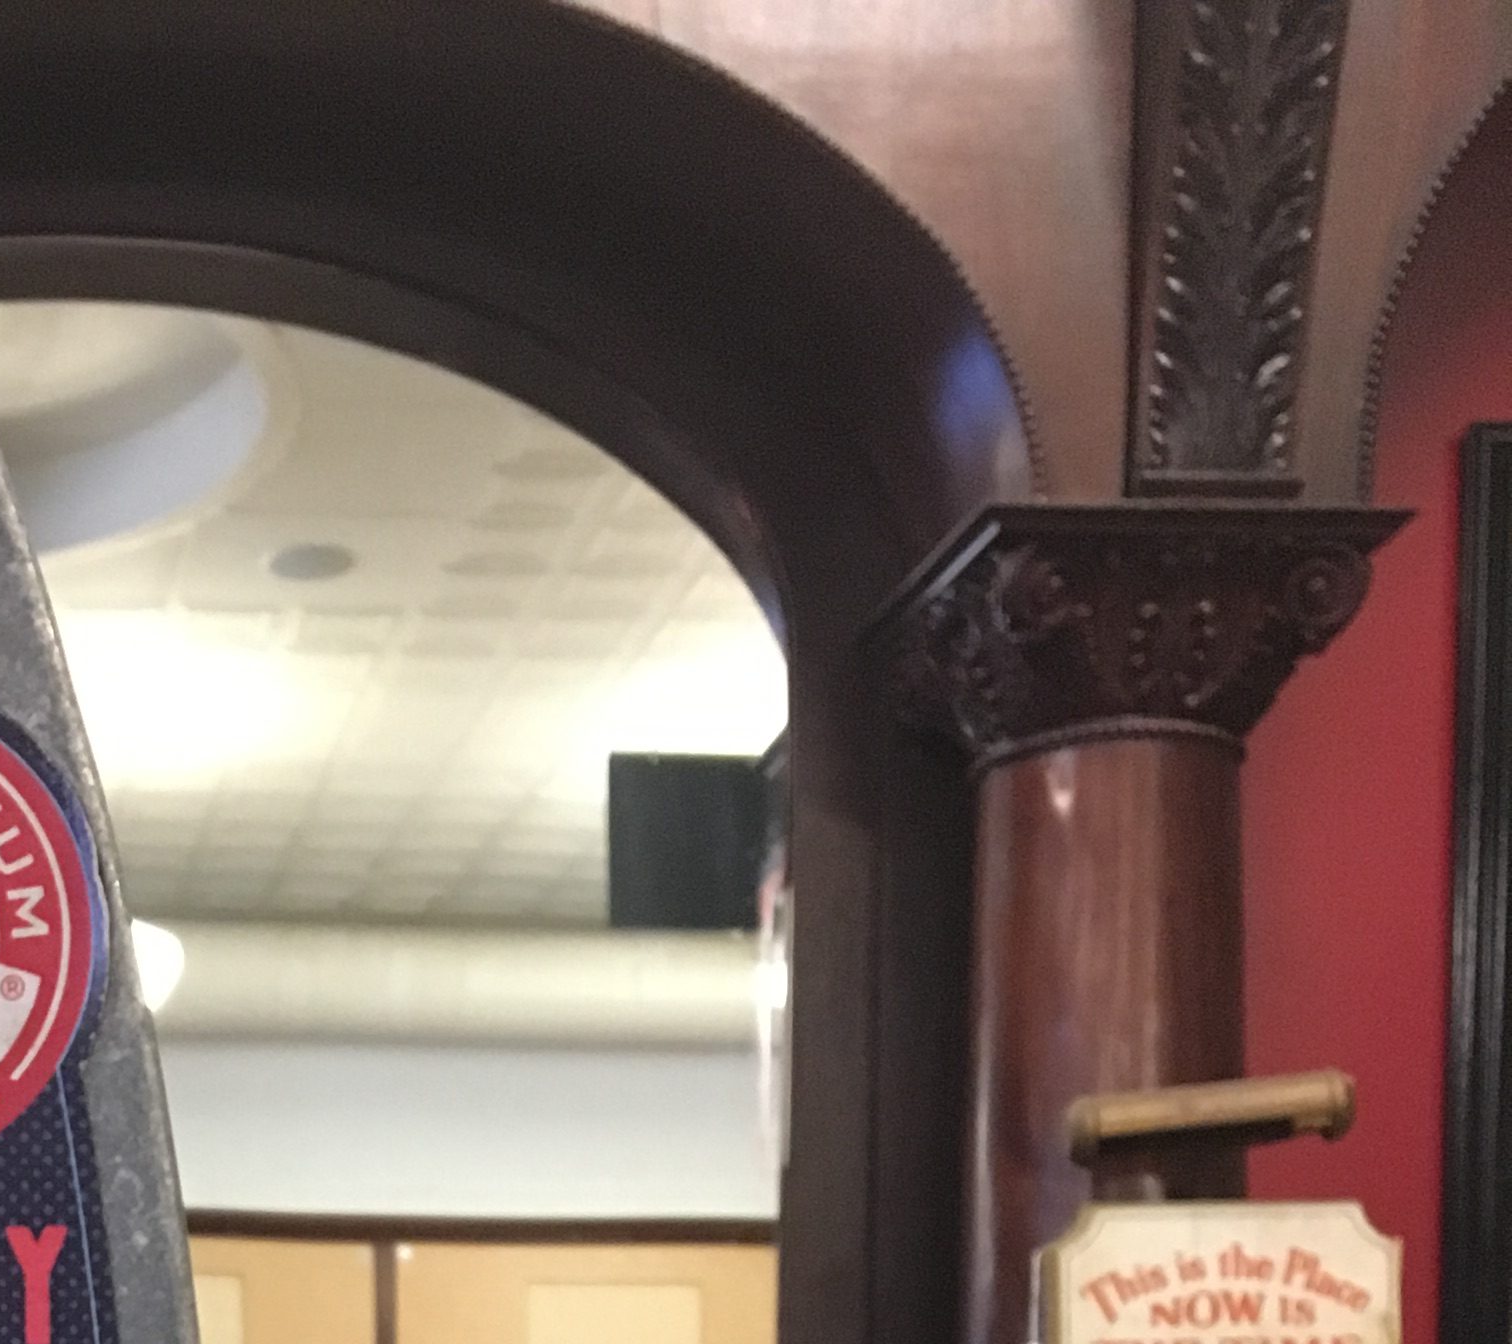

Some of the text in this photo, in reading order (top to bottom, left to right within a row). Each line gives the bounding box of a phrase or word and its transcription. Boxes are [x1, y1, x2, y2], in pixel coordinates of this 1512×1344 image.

[1079, 1241, 1372, 1324] This is the Place
[1149, 1289, 1317, 1329] NOW IS
